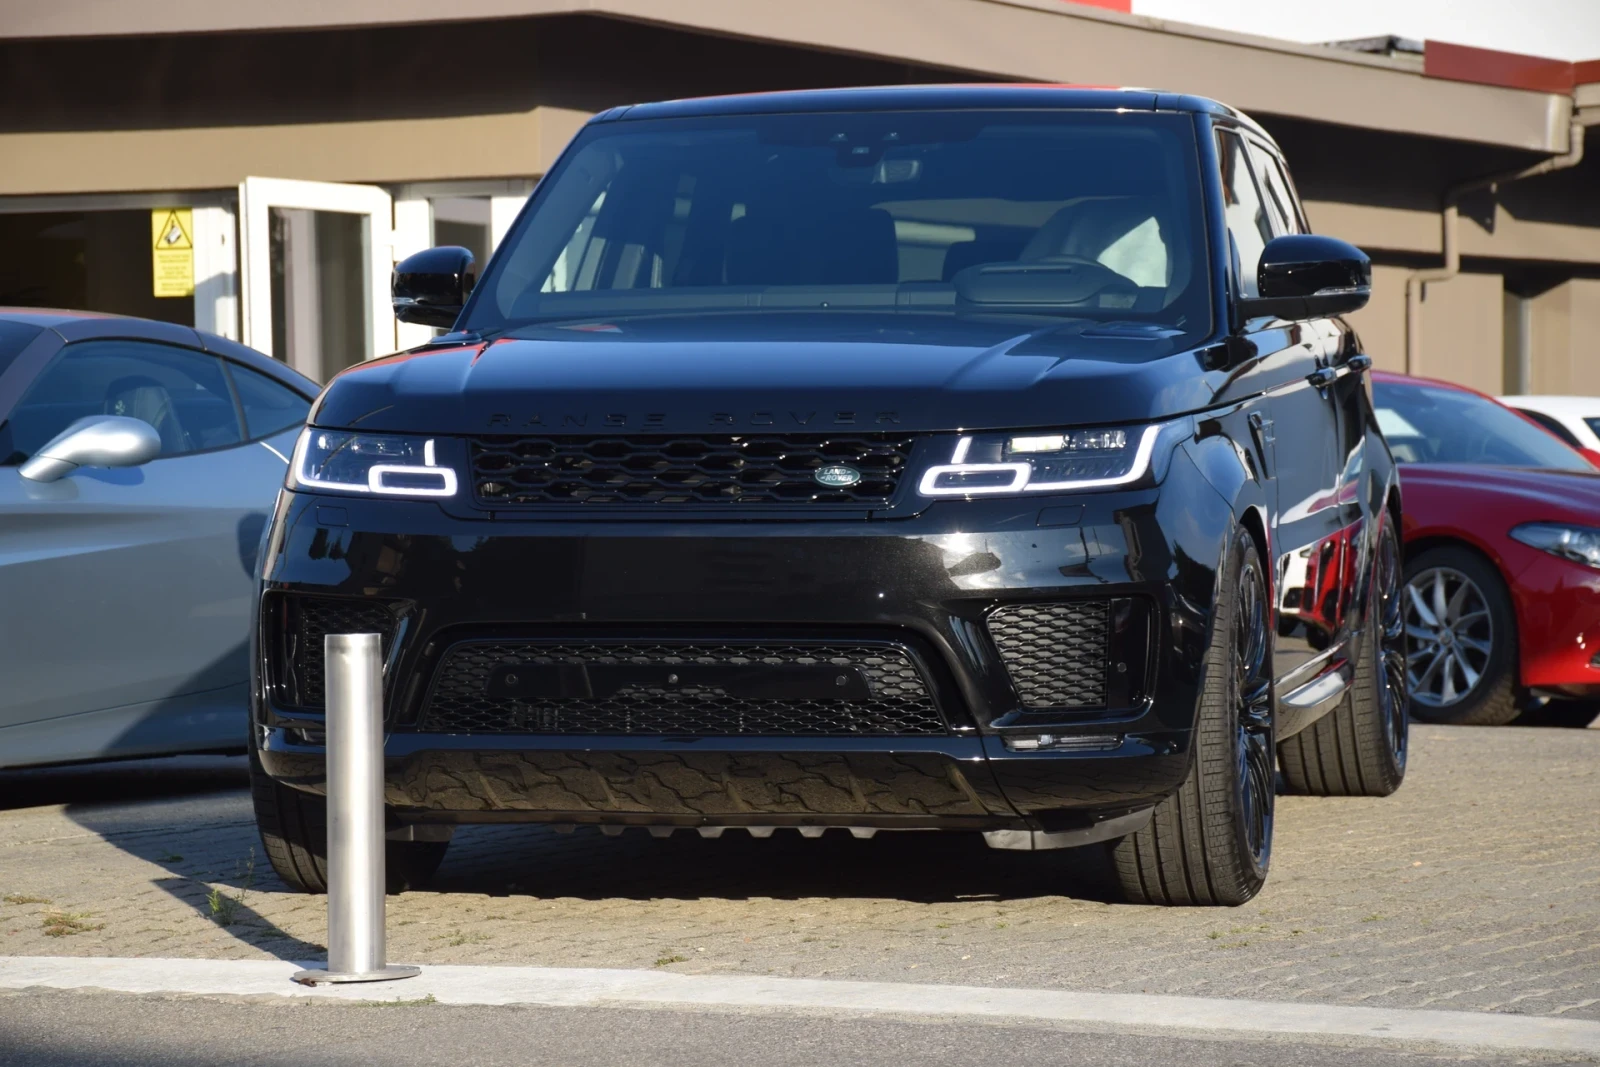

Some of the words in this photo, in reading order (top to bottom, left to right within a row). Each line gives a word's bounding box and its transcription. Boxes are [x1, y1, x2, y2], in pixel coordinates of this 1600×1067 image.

[487, 411, 667, 428] RANGE
[708, 410, 901, 426] ROVER
[825, 474, 854, 482] ROVER
